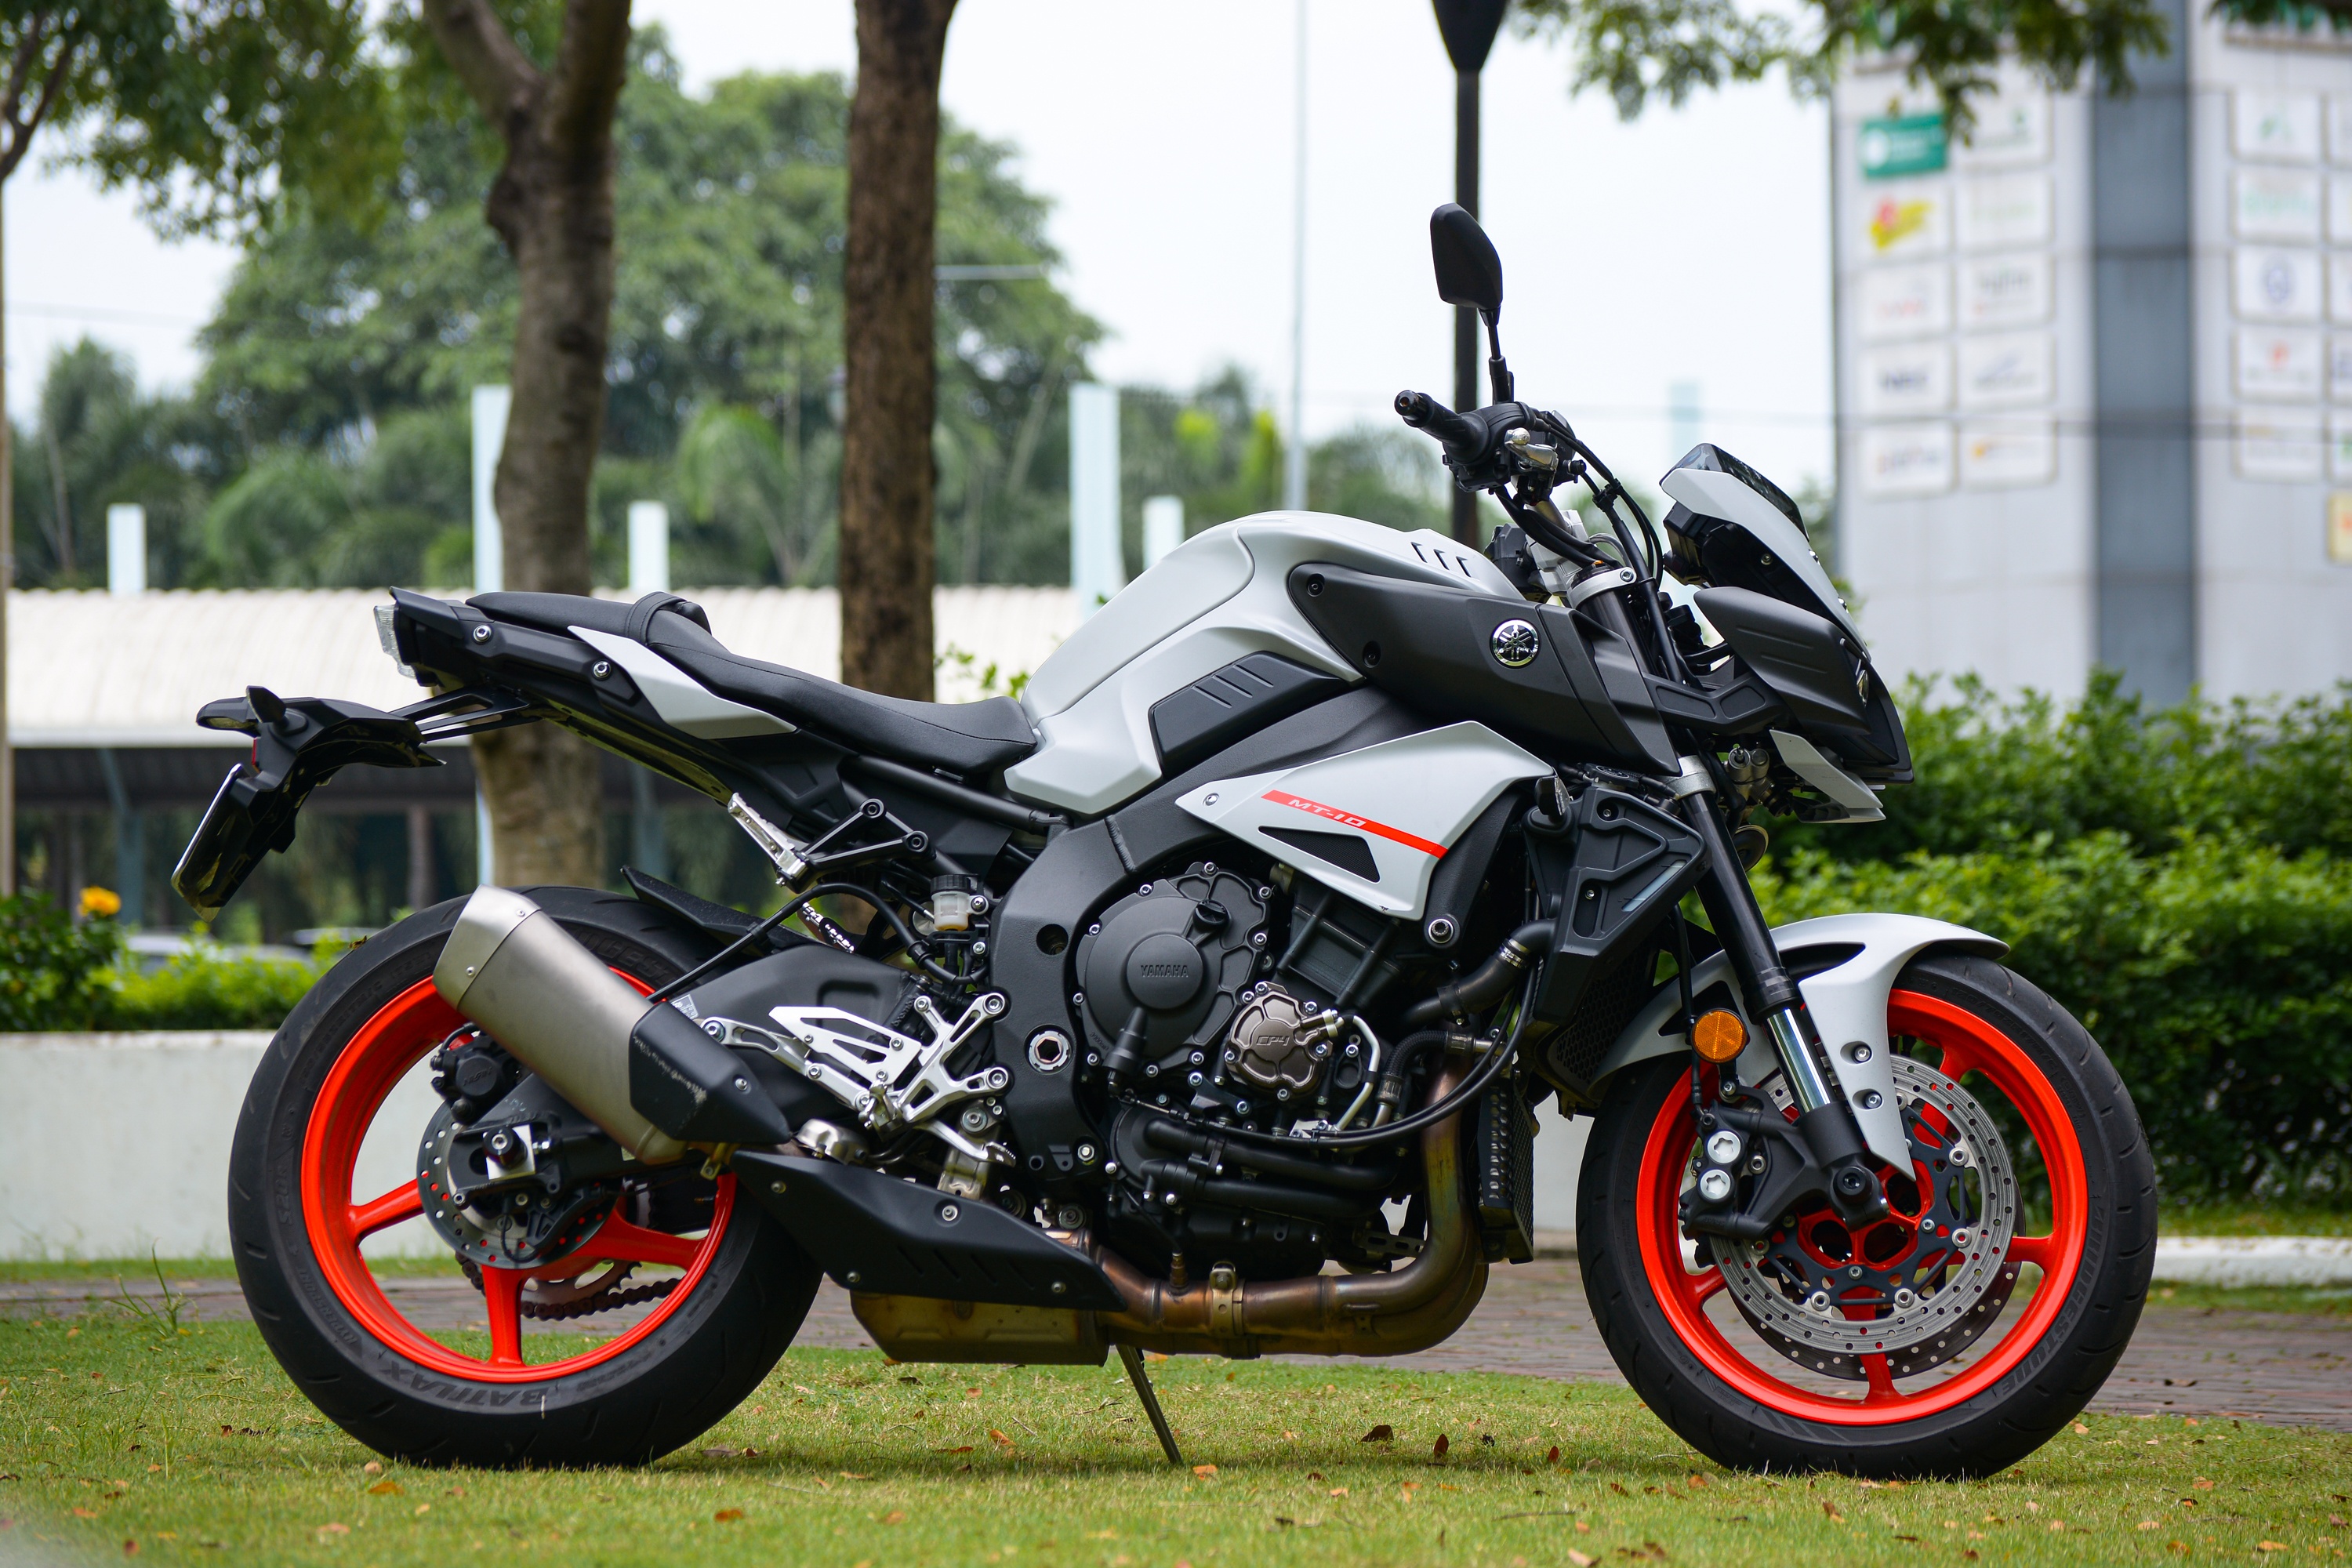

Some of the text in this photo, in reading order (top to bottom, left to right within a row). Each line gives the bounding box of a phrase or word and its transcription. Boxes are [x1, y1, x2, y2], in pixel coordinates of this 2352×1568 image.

[1288, 799, 1367, 827] MT-10
[1140, 964, 1189, 978] YAMAHA
[1256, 1035, 1290, 1047] CP4
[1996, 1205, 2104, 1396] BRIDGESTONE
[381, 1359, 552, 1409] BATTLAX
